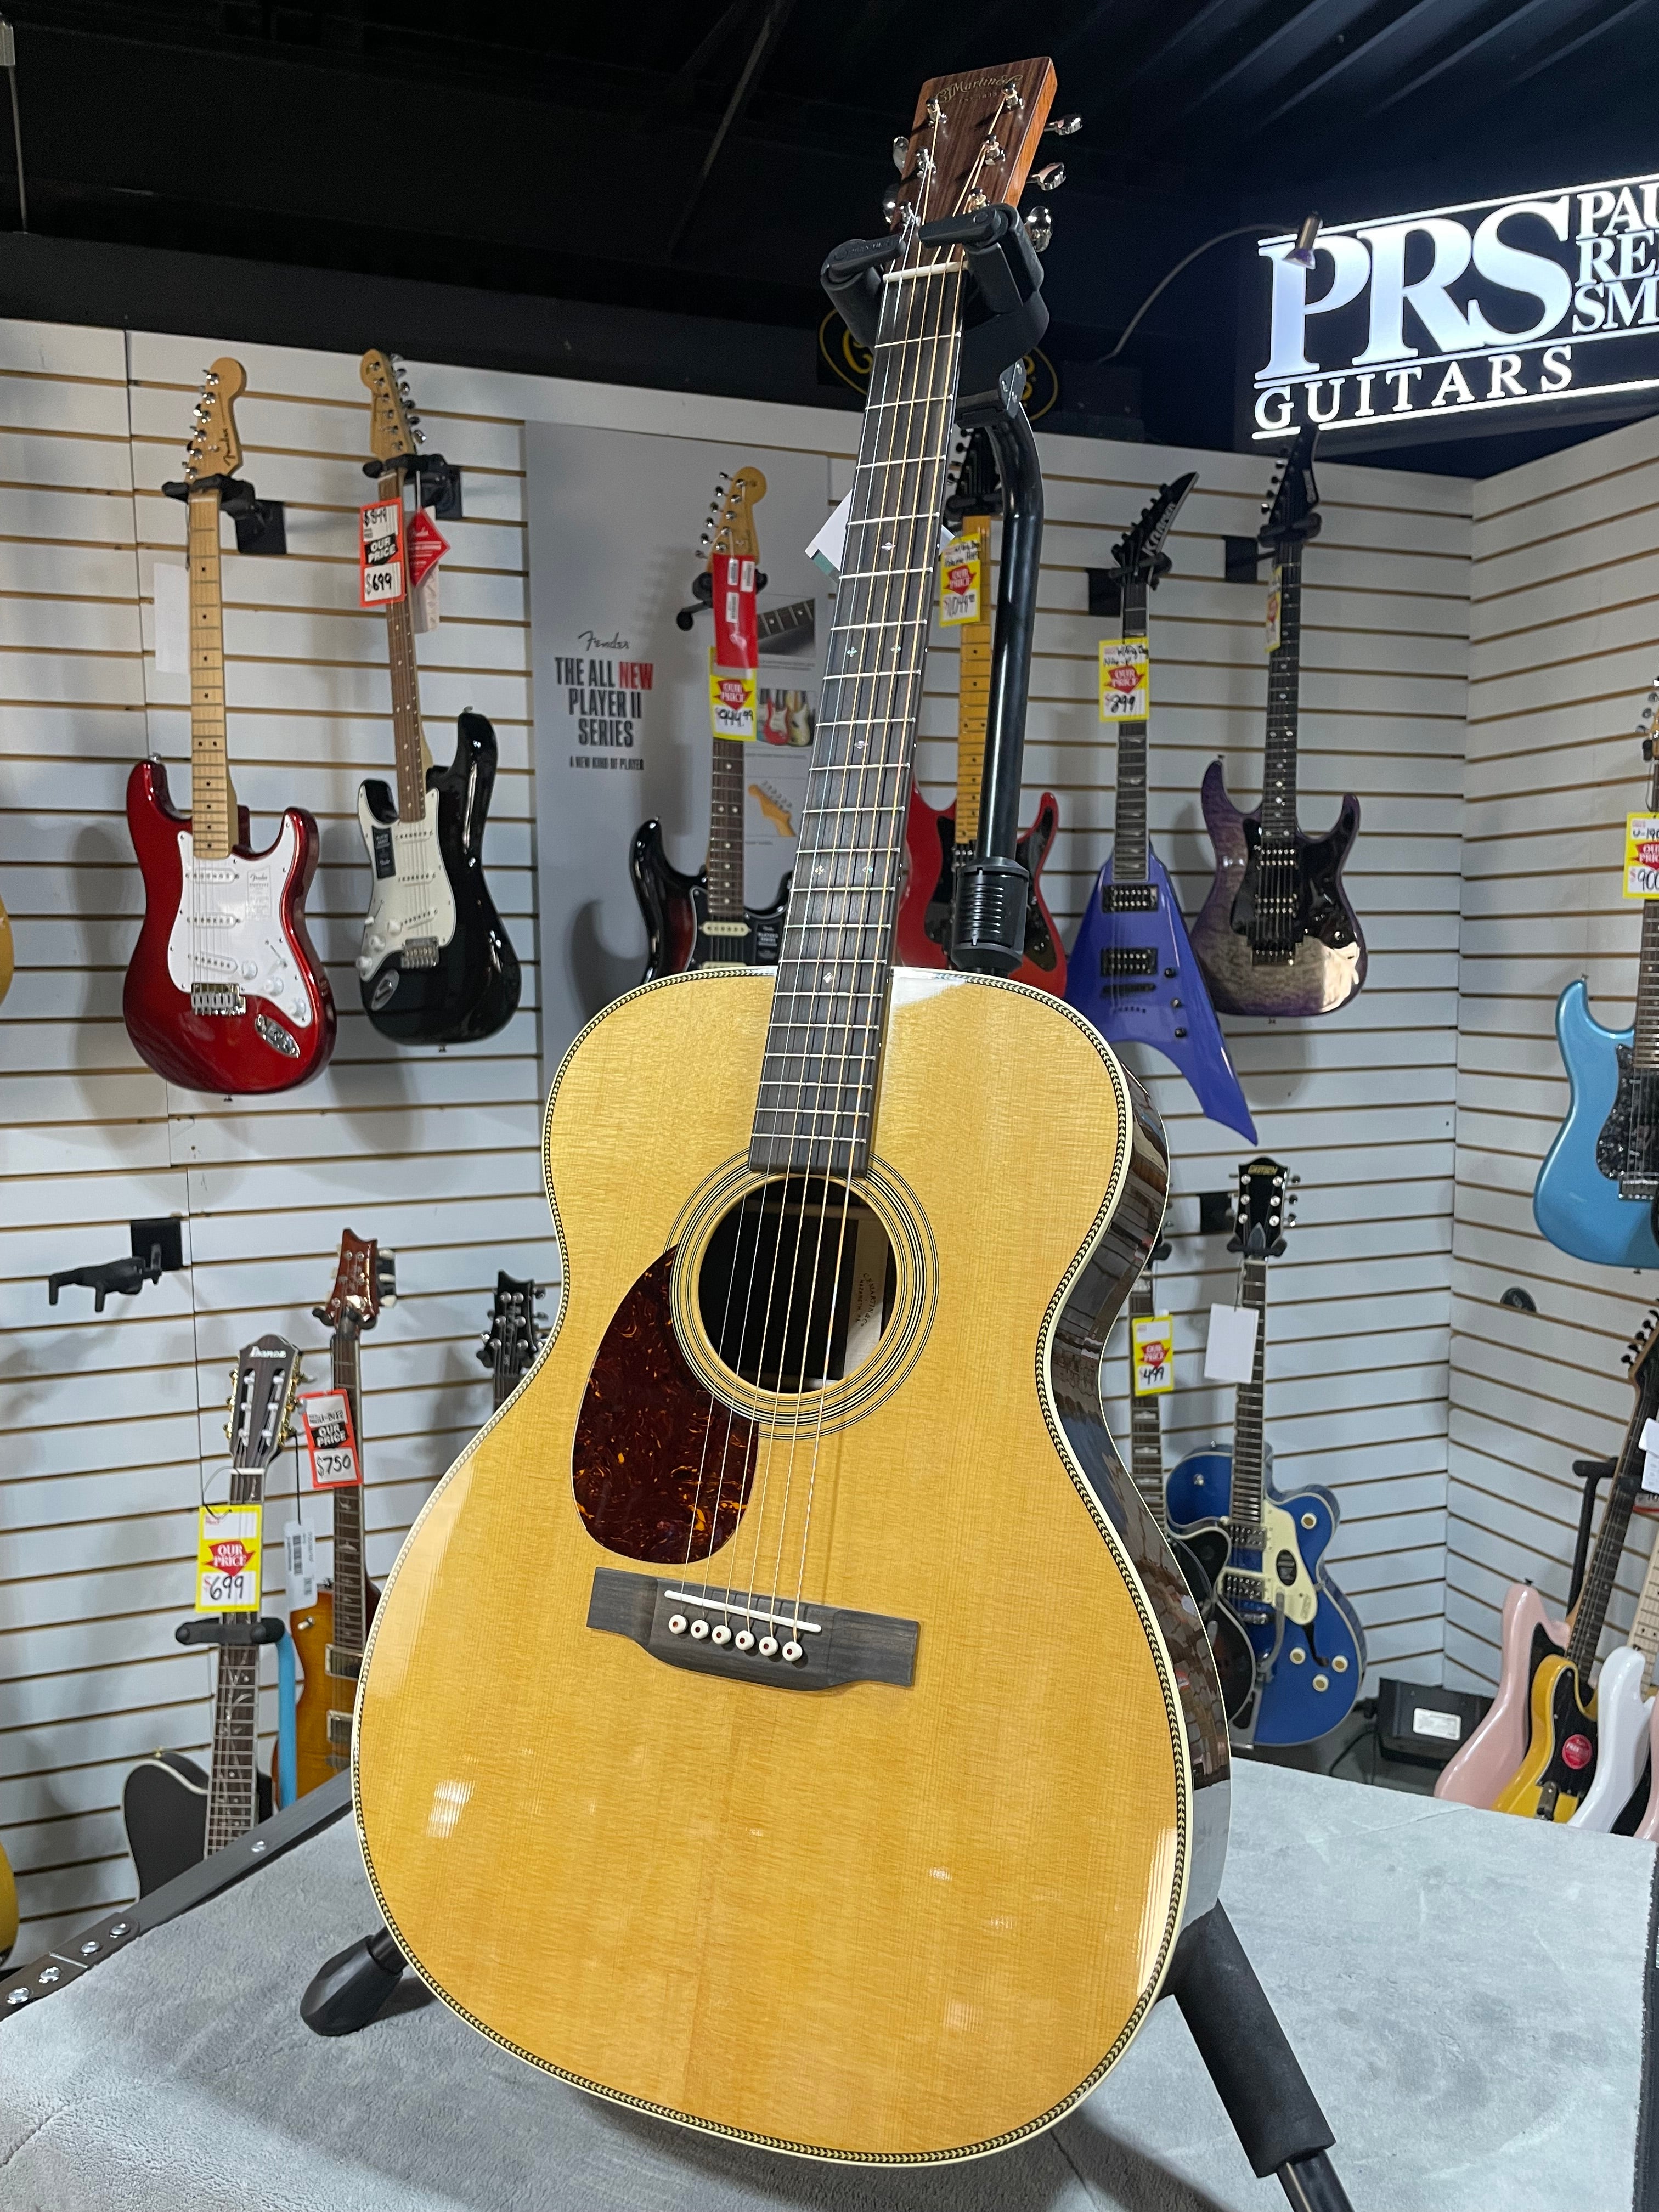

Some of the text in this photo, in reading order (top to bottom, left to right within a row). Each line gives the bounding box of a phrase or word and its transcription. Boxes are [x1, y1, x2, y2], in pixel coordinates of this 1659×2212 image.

[1575, 229, 1659, 286] RE
[1255, 195, 1572, 381] PRS
[1255, 345, 1572, 430] GUITARS
[370, 536, 391, 552] OUR
[368, 544, 396, 563] PRICE
[952, 568, 968, 580] OUR
[366, 572, 392, 595] $699
[950, 578, 970, 589] PRICE
[578, 630, 629, 651] Fender
[555, 657, 653, 690] THE ALL NEW
[1114, 668, 1135, 680] OUR
[723, 683, 742, 693] OUR
[1111, 678, 1138, 688] PRICE
[569, 688, 642, 719] PLAYER II
[720, 692, 744, 703] PRICE
[578, 718, 634, 748] SERIES
[620, 758, 644, 770] PLAYER
[1643, 844, 1659, 854] OU
[868, 1283, 876, 1313] MARTIN
[249, 1345, 287, 1358] Ibanez
[1146, 1344, 1163, 1353] OUR
[1144, 1352, 1164, 1362] PRICE
[318, 1424, 340, 1437] OUR
[317, 1430, 346, 1448] PRICE
[317, 1455, 351, 1476] $750
[217, 1544, 243, 1556] OUR
[213, 1554, 246, 1567] PRICE
[204, 1575, 244, 1600] $699
